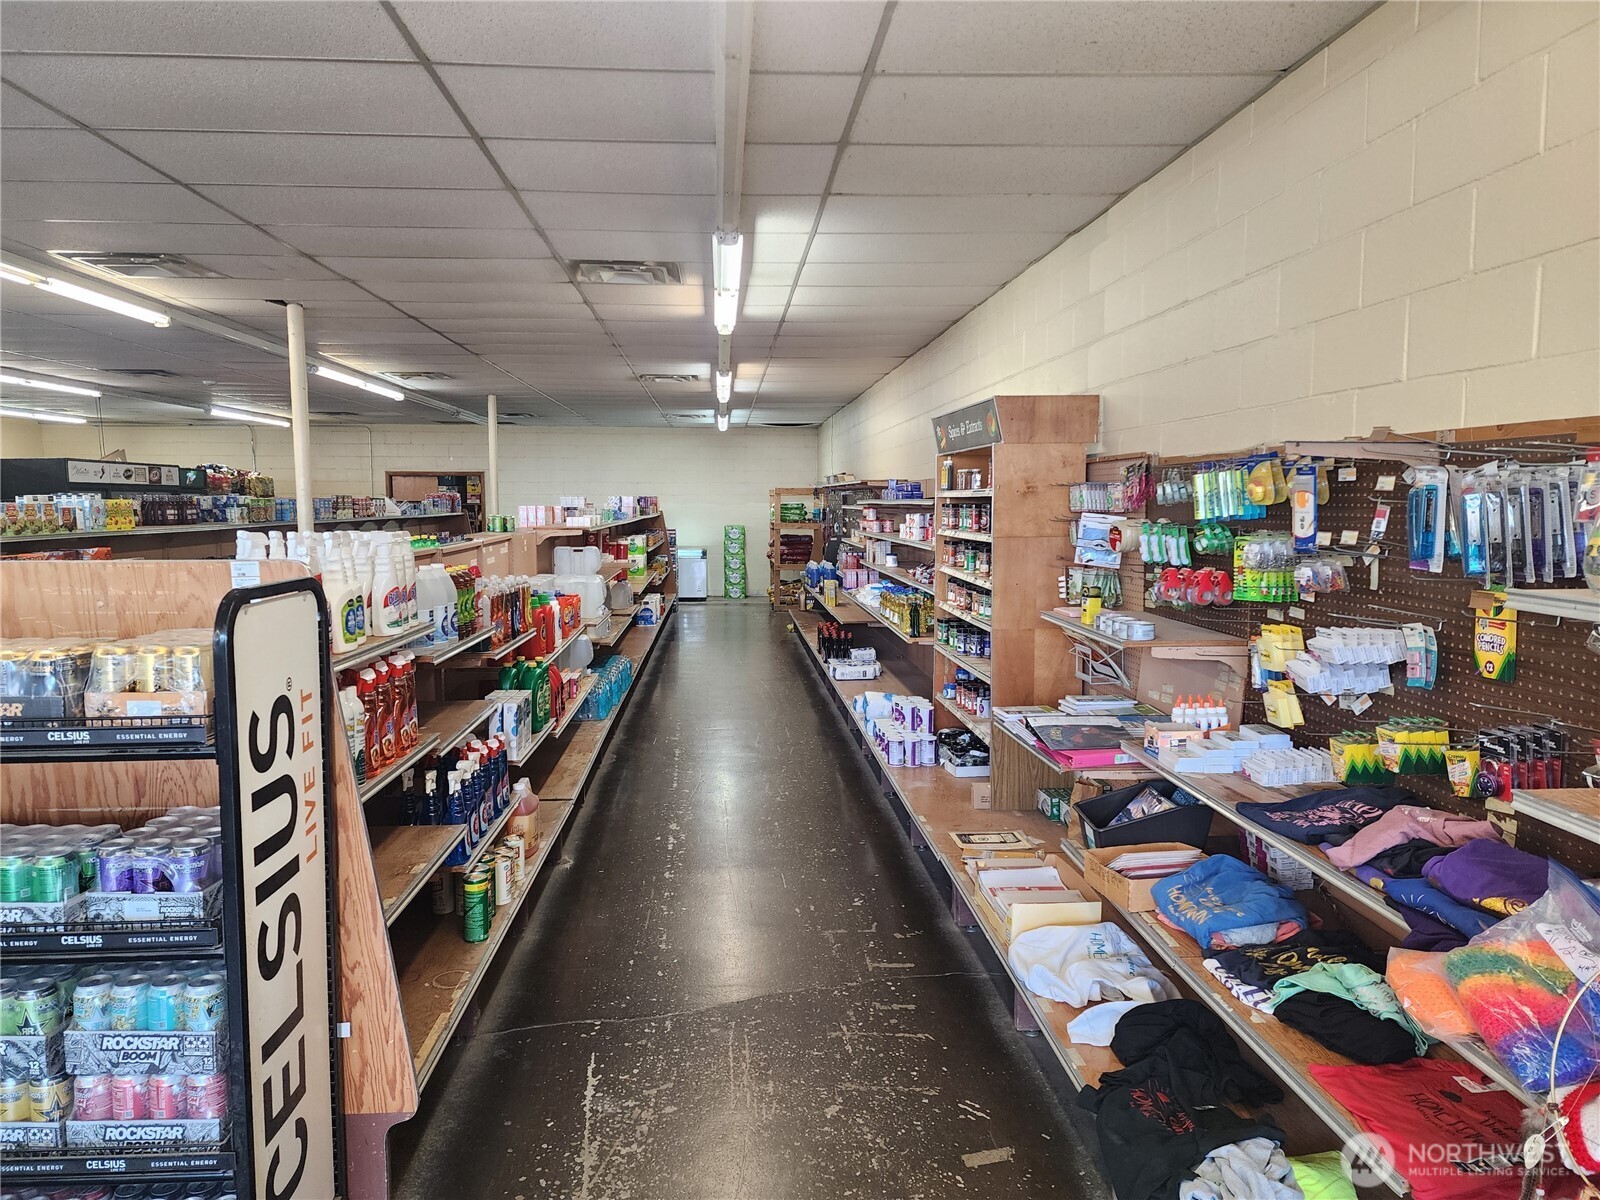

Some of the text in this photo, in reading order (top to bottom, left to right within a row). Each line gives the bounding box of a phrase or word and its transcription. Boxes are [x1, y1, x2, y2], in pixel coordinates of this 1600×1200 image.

[947, 425, 961, 440] Spices
[965, 419, 983, 435] Extracts
[1476, 633, 1506, 646] COLORED
[1477, 642, 1504, 655] PENCILS
[1486, 663, 1494, 672] 12
[47, 731, 90, 741] CELSIUS
[300, 688, 319, 864] LIVE FIT
[160, 906, 194, 914] ROCKSTAR
[61, 934, 103, 945] CELSIUS
[128, 936, 168, 944] ESSENTIAL
[102, 1036, 180, 1051] ROCKSTAR
[121, 1050, 158, 1061] BOOM
[28, 1061, 40, 1070] 12
[202, 1057, 213, 1066] 12
[104, 1126, 185, 1141] ROCKSTAR
[86, 1160, 126, 1169] CELSIUS
[150, 1160, 189, 1168] ESSENTIAL
